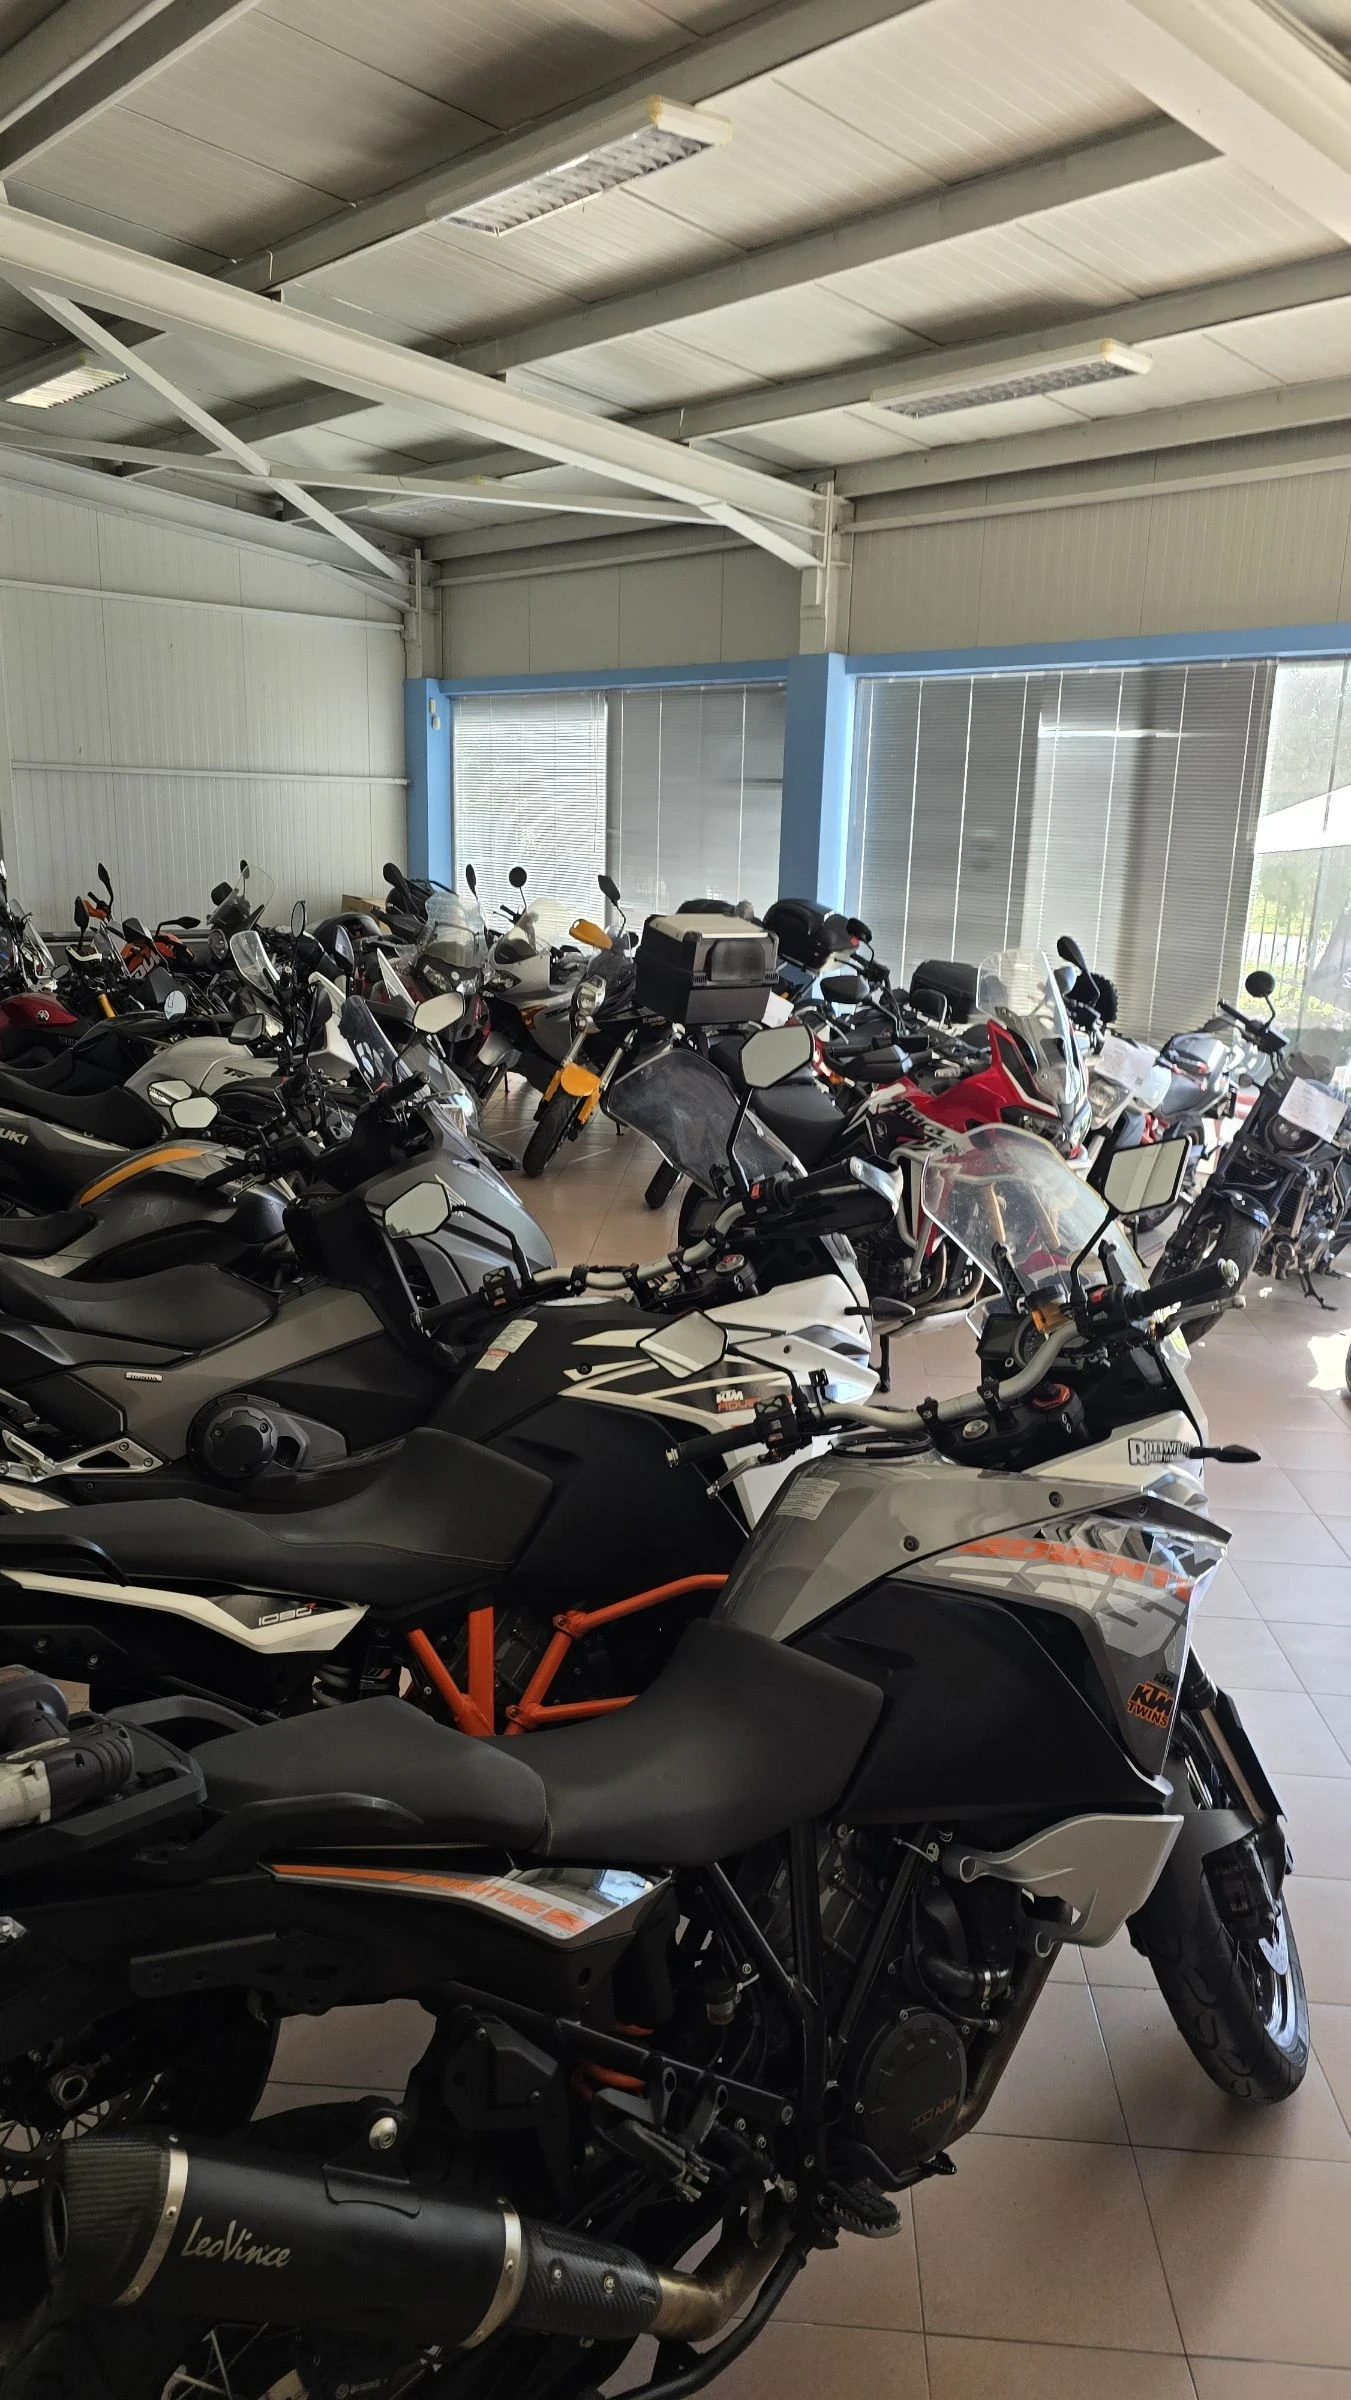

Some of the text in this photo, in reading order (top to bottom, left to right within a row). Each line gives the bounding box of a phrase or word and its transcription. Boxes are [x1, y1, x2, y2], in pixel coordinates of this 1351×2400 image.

[716, 1389, 744, 1403] KTM
[1128, 1700, 1168, 1727] TWINS
[1130, 1682, 1173, 1717] KTM
[181, 2216, 291, 2268] LeoVince
